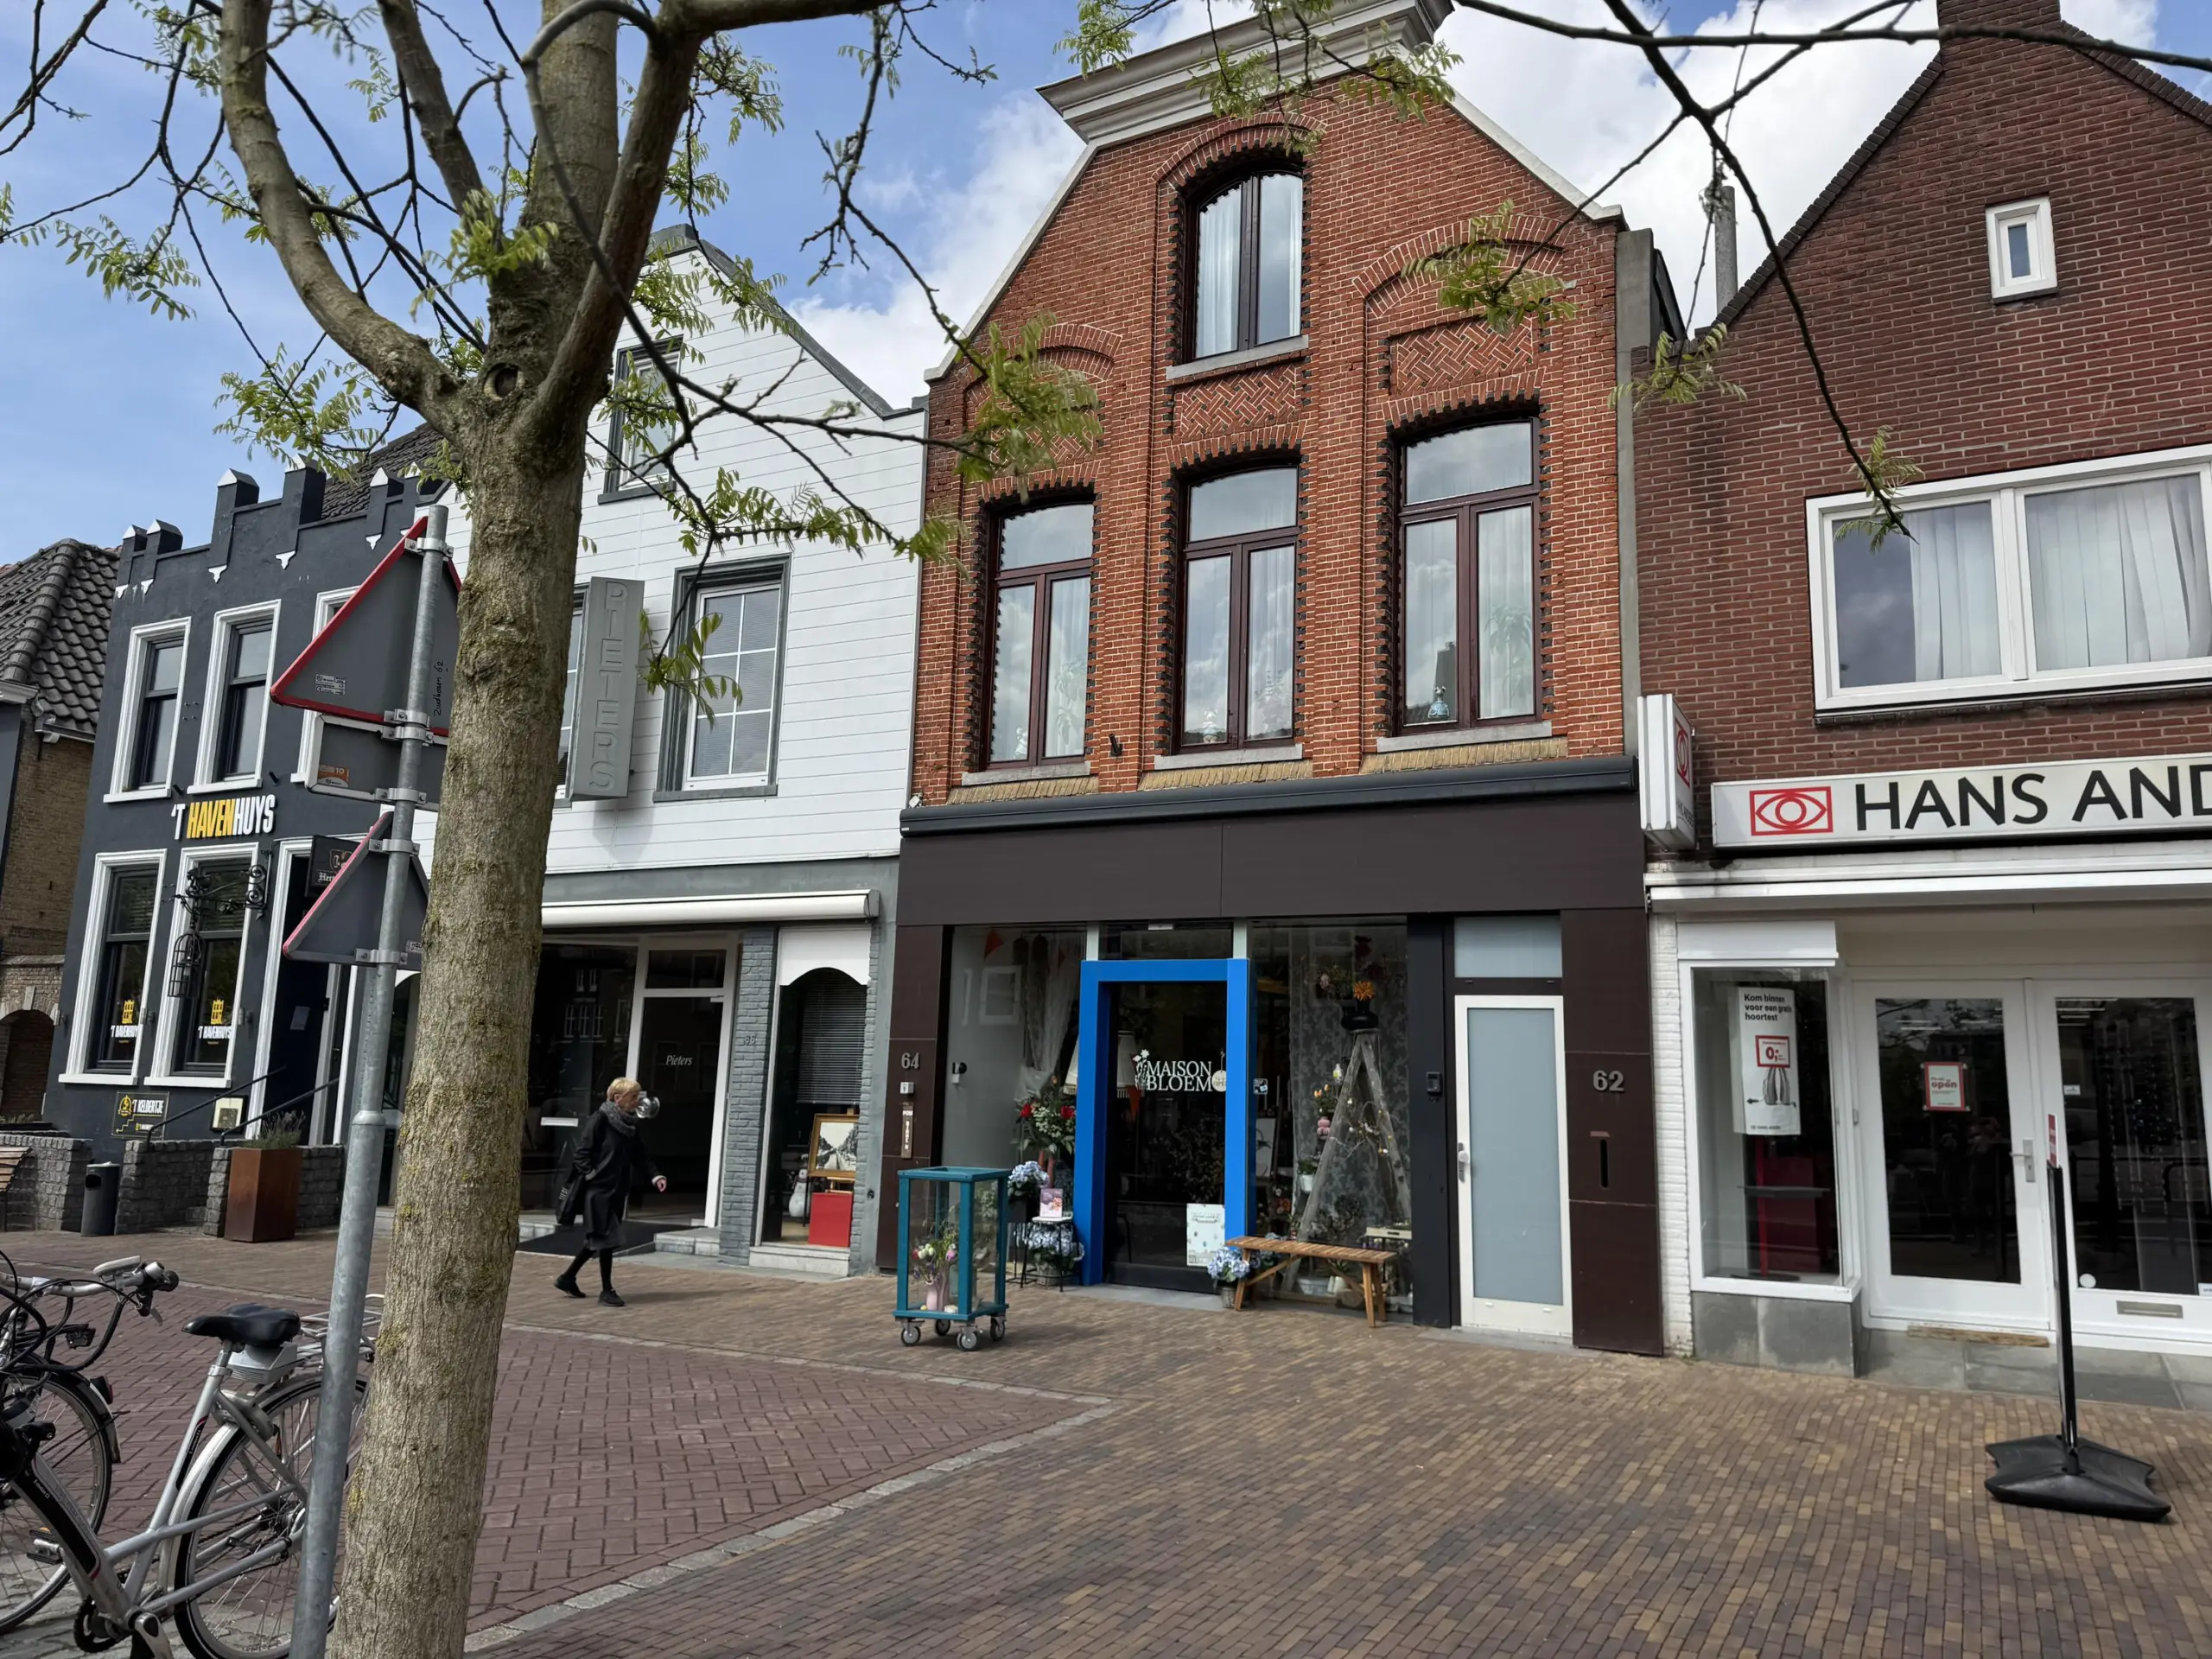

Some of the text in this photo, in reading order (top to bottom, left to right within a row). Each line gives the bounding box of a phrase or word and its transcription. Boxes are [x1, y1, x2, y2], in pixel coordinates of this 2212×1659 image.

[589, 581, 628, 791] PIETERS
[1855, 772, 2048, 831] HANS
[187, 794, 276, 839] HAVENHUYS
[1745, 1013, 1778, 1021] hoortest
[665, 1055, 693, 1065] Pieters
[901, 1052, 919, 1069] 64
[1147, 1060, 1212, 1077] MAISON
[1147, 1076, 1213, 1091] BLOEM
[1592, 1070, 1624, 1091] 62
[1931, 1081, 1957, 1090] open
